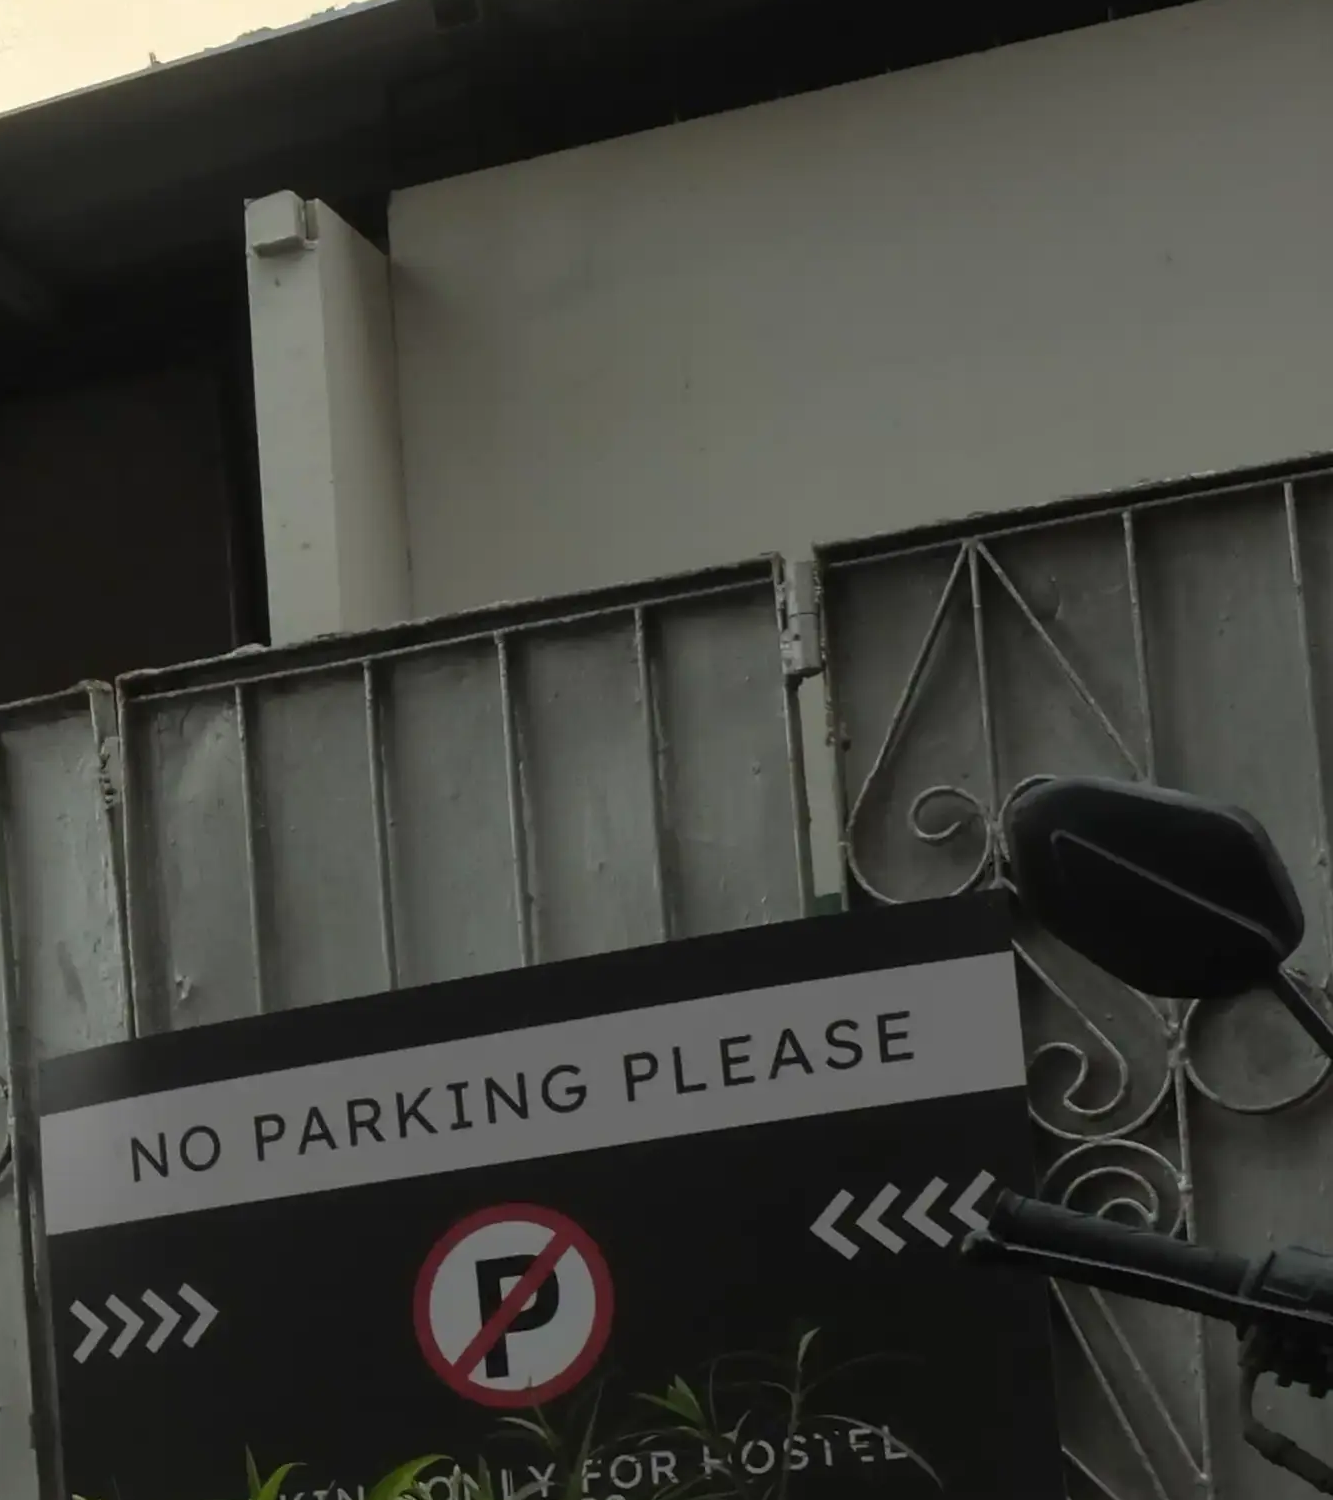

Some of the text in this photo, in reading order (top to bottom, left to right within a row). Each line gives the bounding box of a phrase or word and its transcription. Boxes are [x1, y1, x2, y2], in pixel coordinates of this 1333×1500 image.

[129, 1011, 915, 1183] NO PARKING PLEASE
[581, 1449, 680, 1494] FOR
